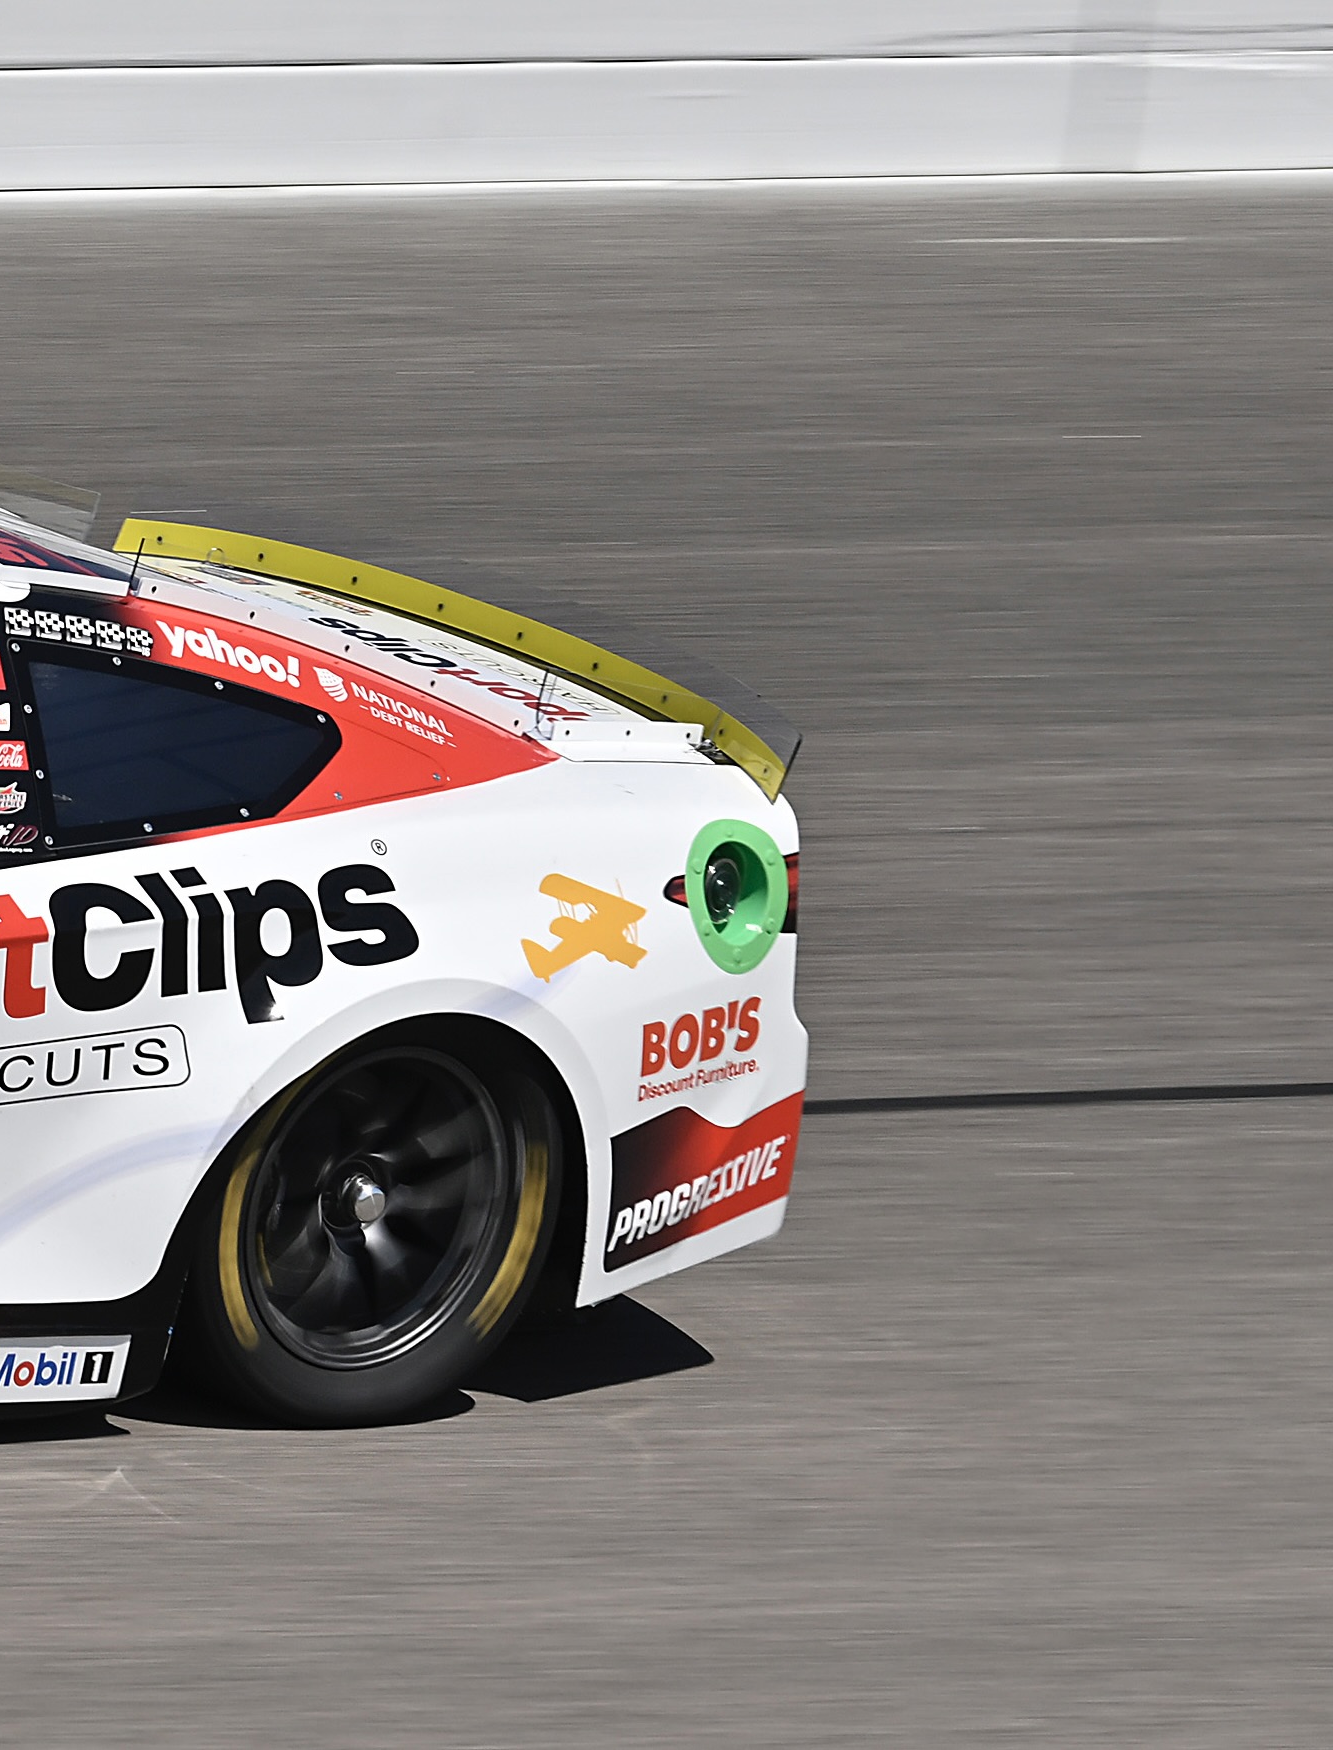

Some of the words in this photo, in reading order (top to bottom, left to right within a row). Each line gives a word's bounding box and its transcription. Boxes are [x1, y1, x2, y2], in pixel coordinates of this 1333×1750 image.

[155, 620, 301, 688] yahoo!
[307, 617, 593, 721] portClips
[350, 682, 453, 738] NATIONAL
[370, 706, 403, 727] DEBT
[405, 720, 446, 746] RELIEF
[640, 996, 762, 1078] BOB'S
[638, 1073, 694, 1102] Discount
[607, 1136, 786, 1252] PROGRESSIVE
